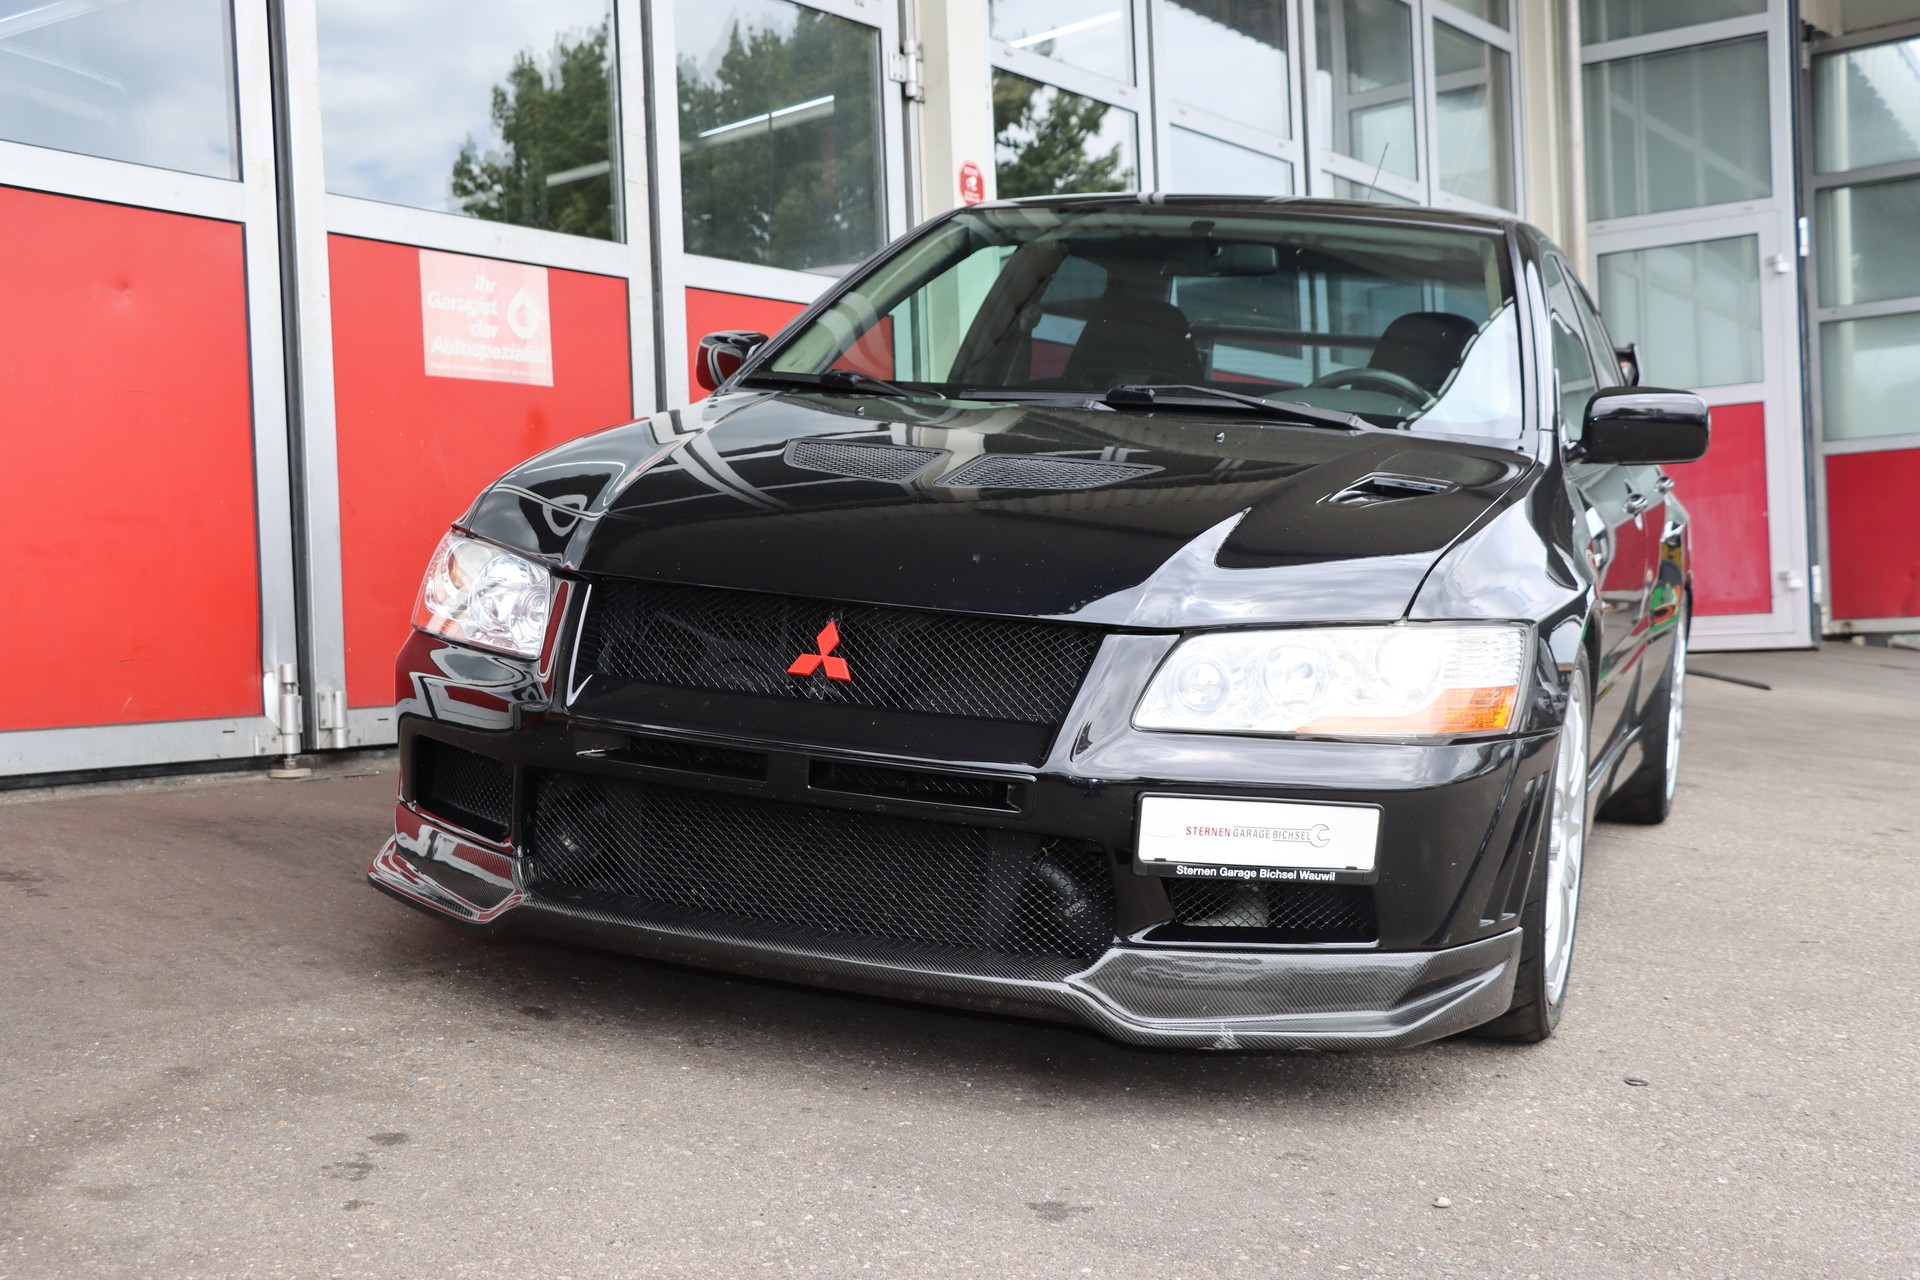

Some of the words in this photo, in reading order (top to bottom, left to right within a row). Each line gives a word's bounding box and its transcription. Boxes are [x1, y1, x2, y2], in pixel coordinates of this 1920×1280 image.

[475, 274, 497, 293] Ihr
[427, 290, 498, 317] Garagist
[470, 320, 499, 338] der
[430, 335, 546, 363] Autospezialist
[1186, 826, 1231, 837] STERNEN
[1233, 828, 1270, 839] GARAGE
[1272, 830, 1311, 841] BICHSEL
[1176, 865, 1217, 876] Sternen
[1219, 868, 1257, 879] Garage
[1259, 869, 1297, 880] Bichsel
[1299, 870, 1336, 881] Wauwil
